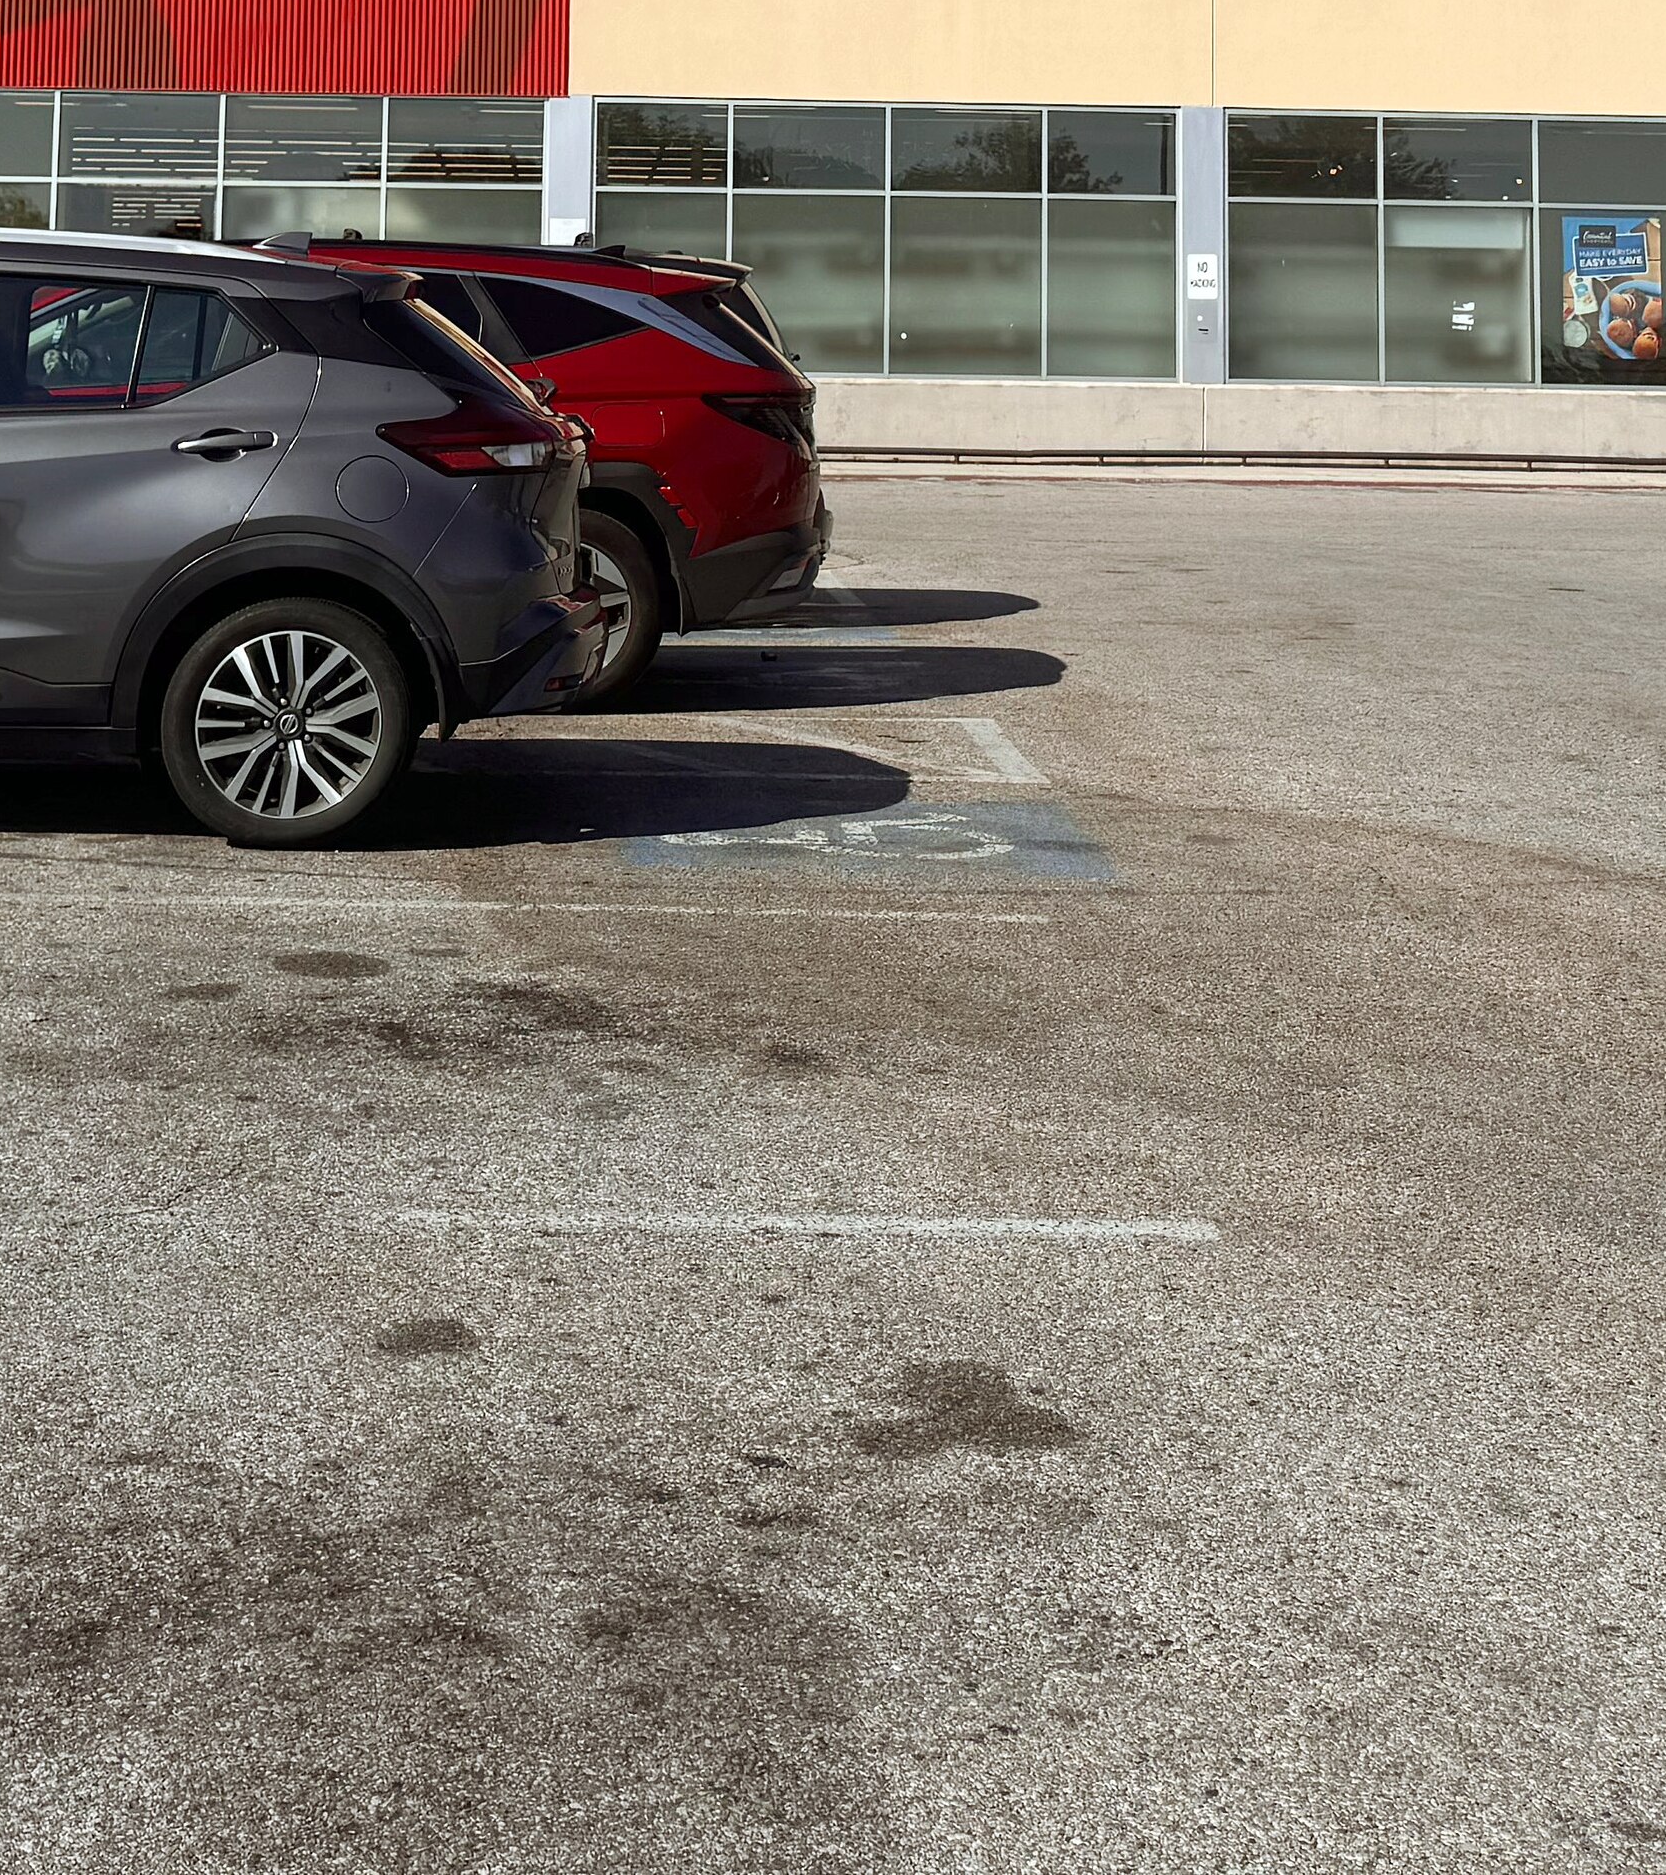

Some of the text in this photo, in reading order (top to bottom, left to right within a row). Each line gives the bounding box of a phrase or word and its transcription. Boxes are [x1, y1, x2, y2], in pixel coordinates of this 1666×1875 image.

[1579, 248, 1642, 258] MAKE EVERYDAY
[1197, 261, 1208, 273] NO
[1579, 256, 1643, 268] EASY to SAVE
